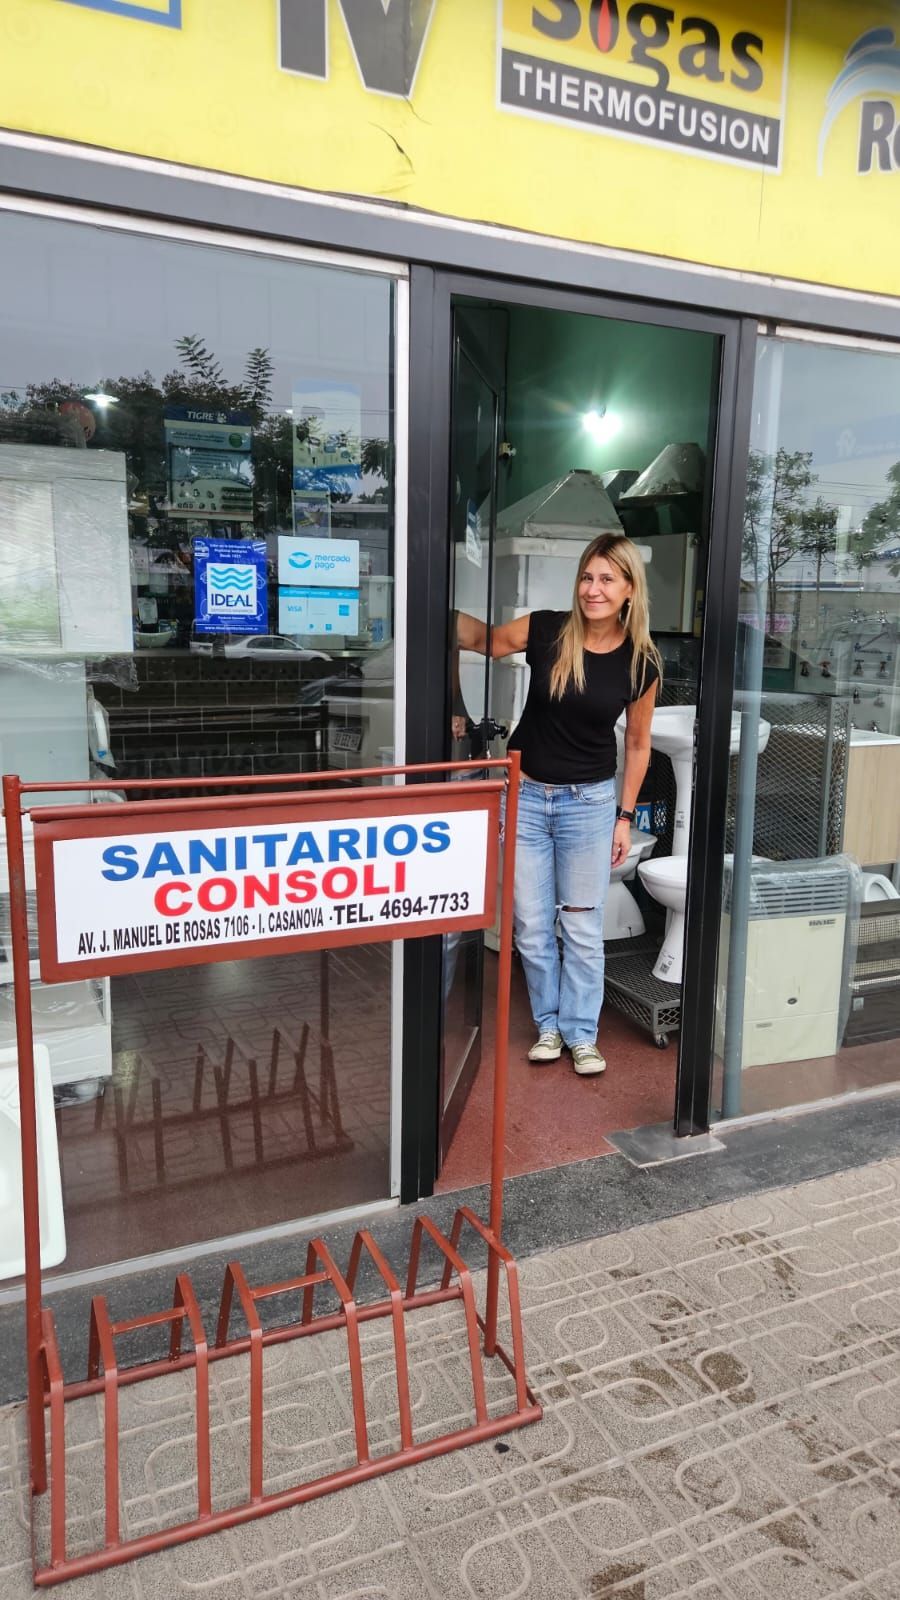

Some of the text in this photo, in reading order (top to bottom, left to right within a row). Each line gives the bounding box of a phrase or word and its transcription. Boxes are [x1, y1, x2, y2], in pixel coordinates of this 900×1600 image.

[511, 62, 771, 156] THERMOFUSION
[186, 410, 214, 421] TIGRE
[314, 554, 351, 563] mercado
[314, 562, 336, 570] pago
[210, 593, 253, 607] IDEAL
[101, 821, 451, 882] SANITARIOS
[154, 861, 406, 917] CONSOLI
[78, 931, 96, 955] AV.
[99, 929, 110, 952] J.
[113, 924, 162, 951] MANUEL
[165, 921, 181, 945] DE
[184, 917, 221, 943] ROSAS
[224, 914, 250, 937] 7106
[268, 906, 324, 933] CASANOVA
[379, 891, 469, 919] 4694-7733
